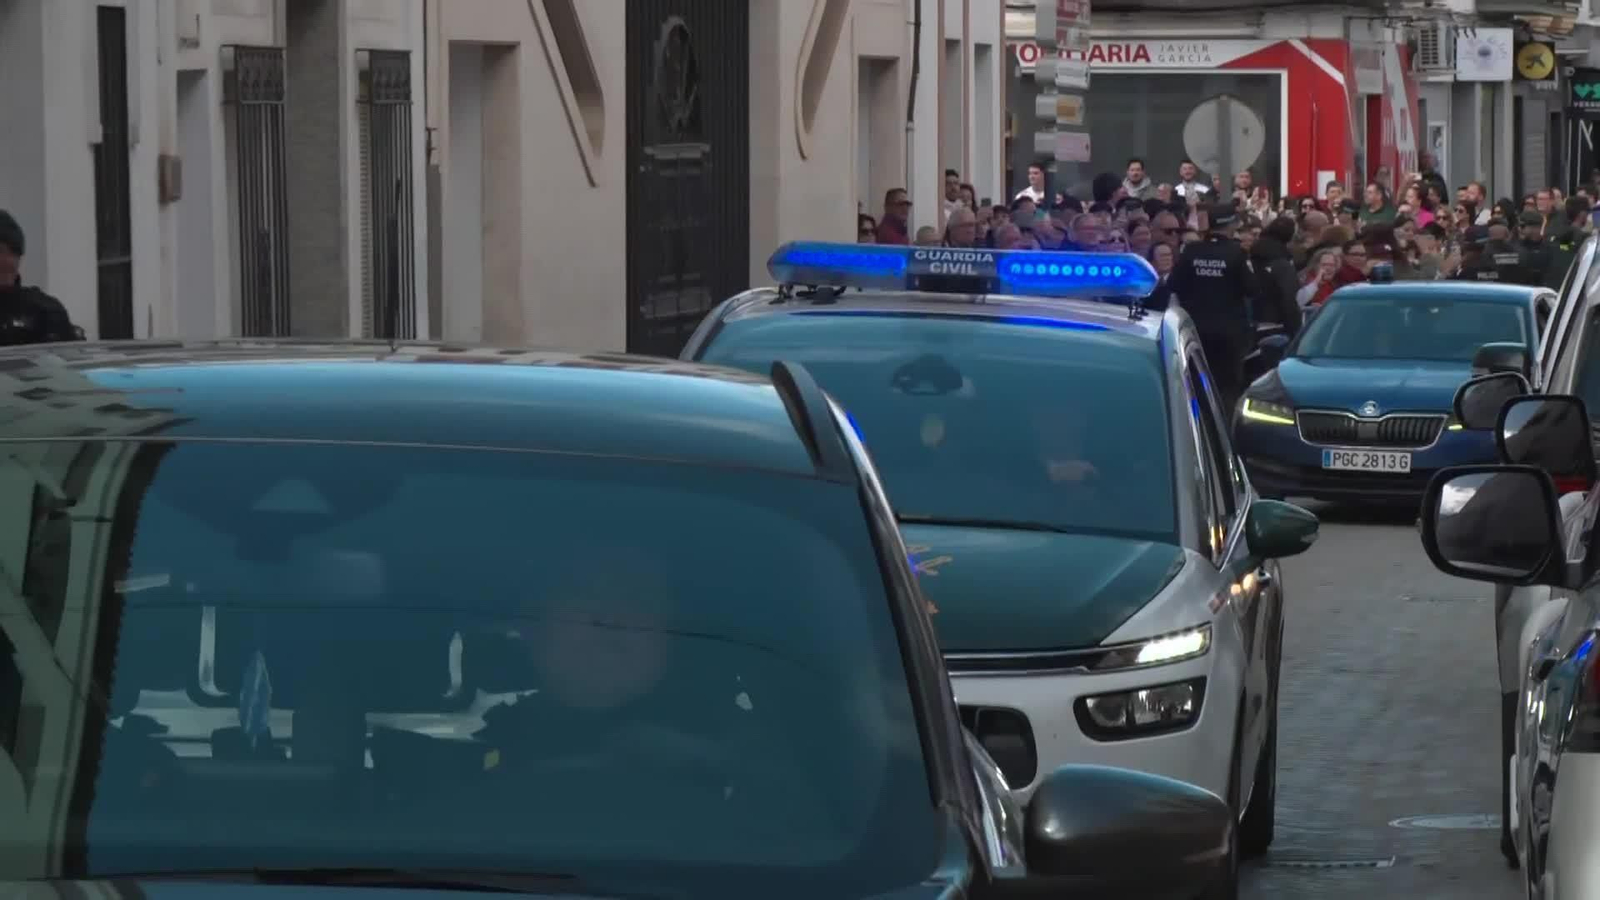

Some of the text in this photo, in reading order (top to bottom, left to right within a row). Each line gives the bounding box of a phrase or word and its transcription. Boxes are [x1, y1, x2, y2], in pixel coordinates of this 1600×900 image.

[1012, 44, 1151, 63] OARIA
[914, 250, 994, 262] GUARDIA
[930, 262, 978, 275] CIVIL
[1196, 267, 1224, 277] LOCAL
[1333, 452, 1409, 469] PGC 2813 G
